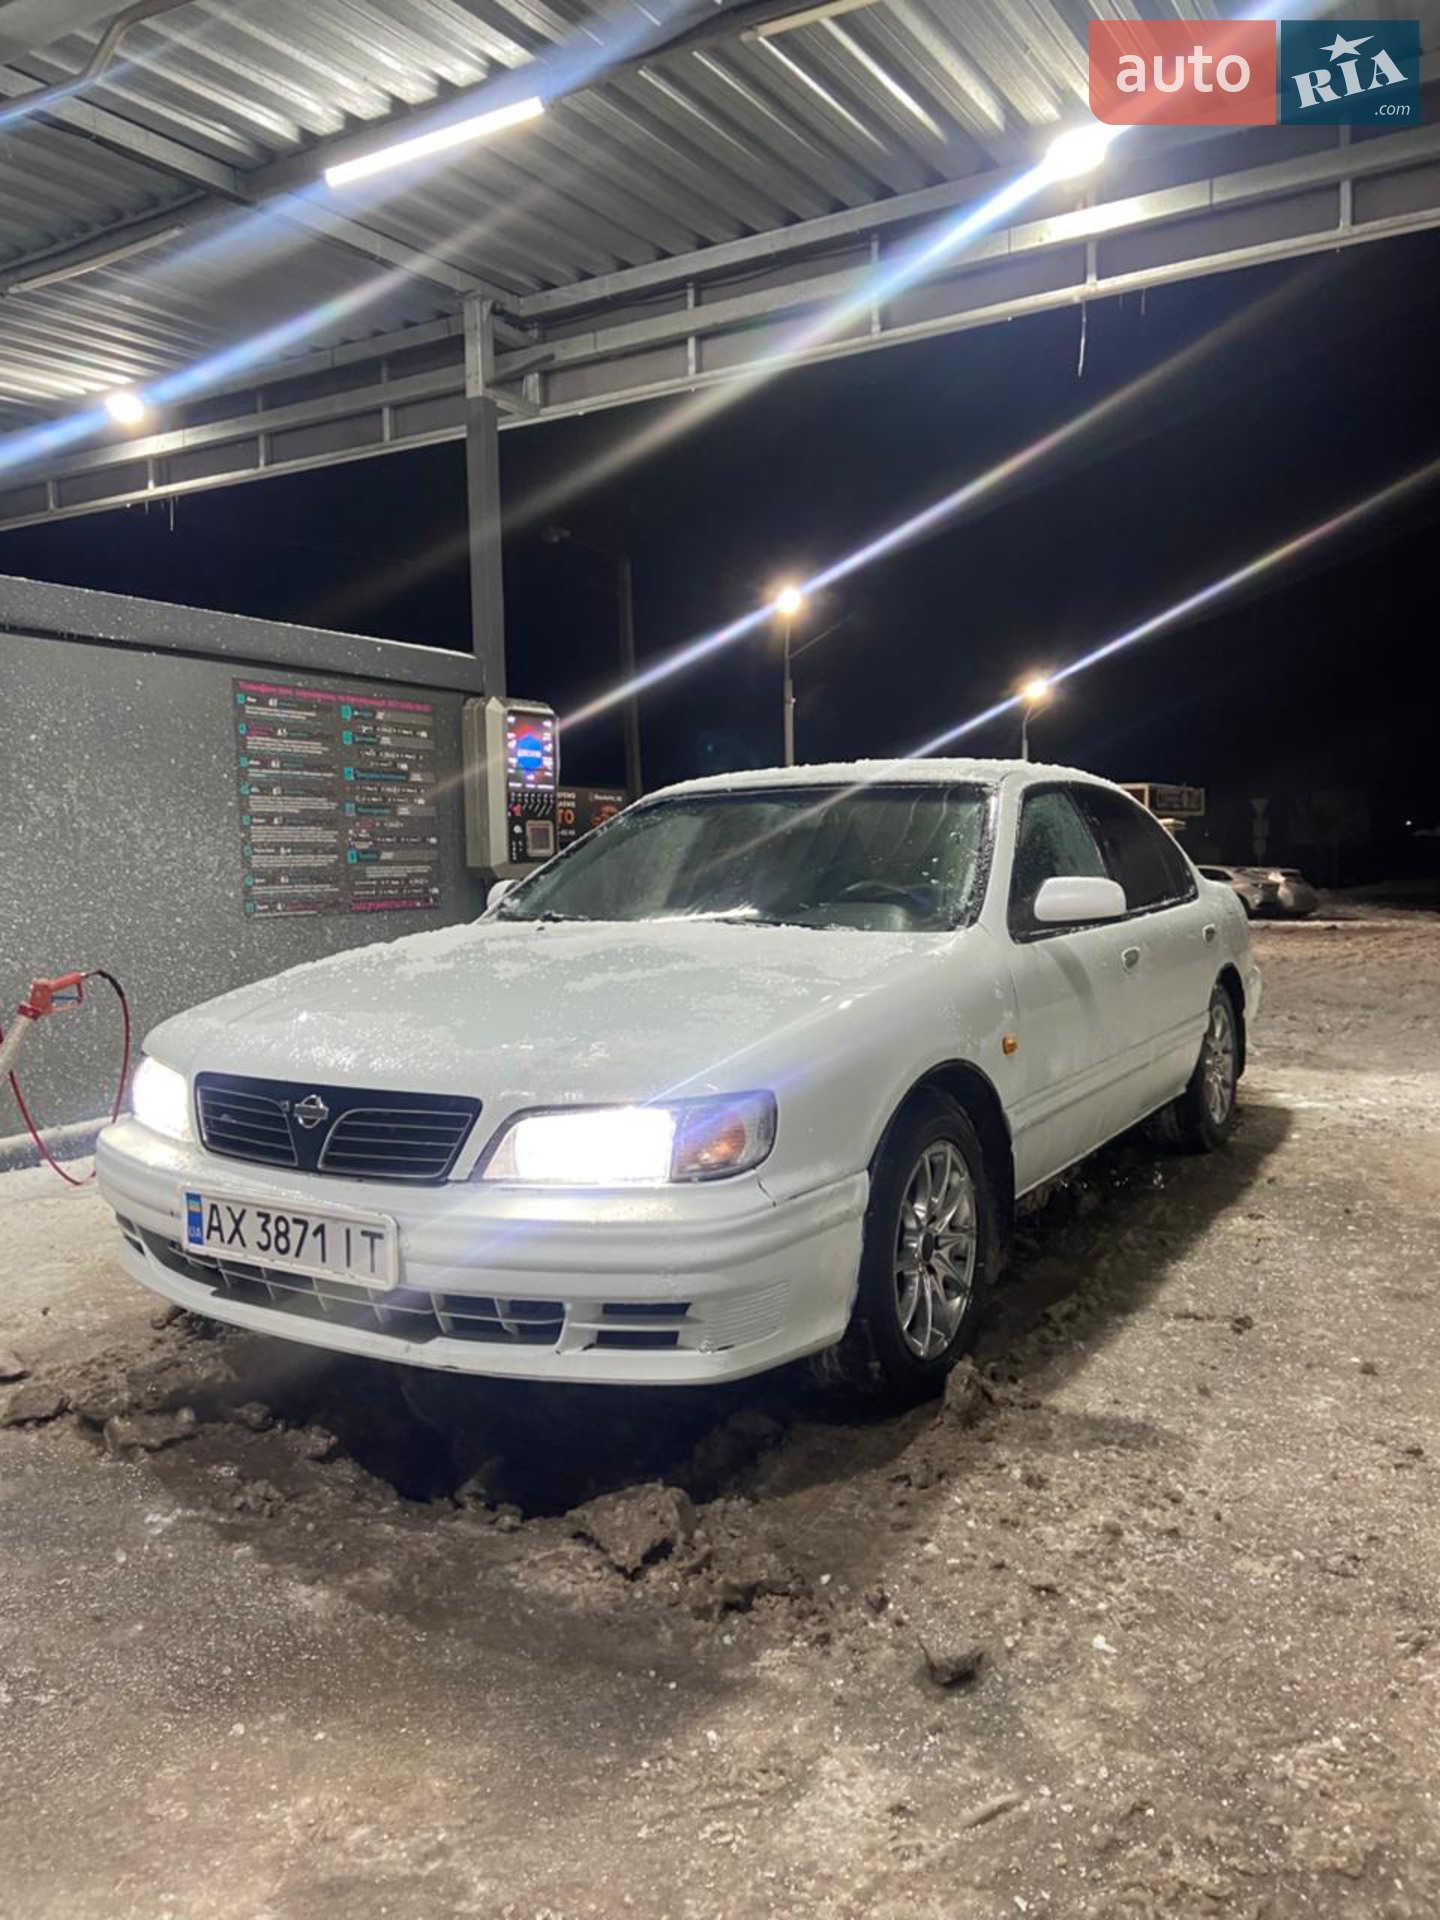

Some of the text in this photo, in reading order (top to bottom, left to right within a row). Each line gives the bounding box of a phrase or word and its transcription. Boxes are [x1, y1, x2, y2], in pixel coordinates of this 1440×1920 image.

[206, 1203, 385, 1273] AX 3871 IT
